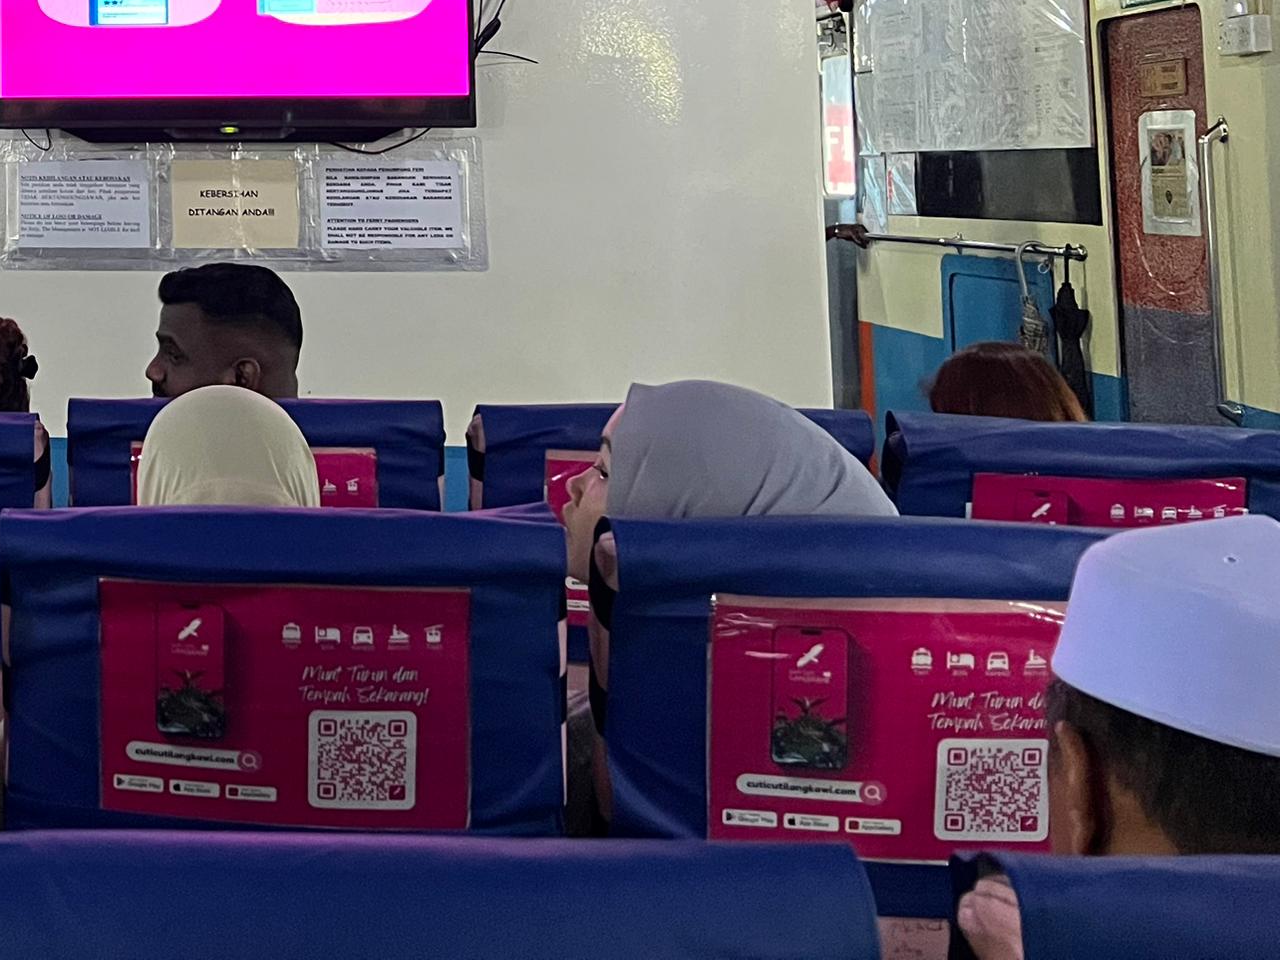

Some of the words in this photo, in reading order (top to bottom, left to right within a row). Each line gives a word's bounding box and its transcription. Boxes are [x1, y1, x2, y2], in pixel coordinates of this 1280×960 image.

[189, 208, 238, 216] DITANGAN
[302, 665, 342, 683] Muat
[347, 664, 388, 682] Turun
[393, 666, 418, 683] dan
[299, 685, 351, 705] Tempah
[356, 685, 430, 706] Sekarang!
[931, 691, 975, 709] Muat
[980, 691, 1024, 709] Turun
[927, 712, 983, 733] Tempah
